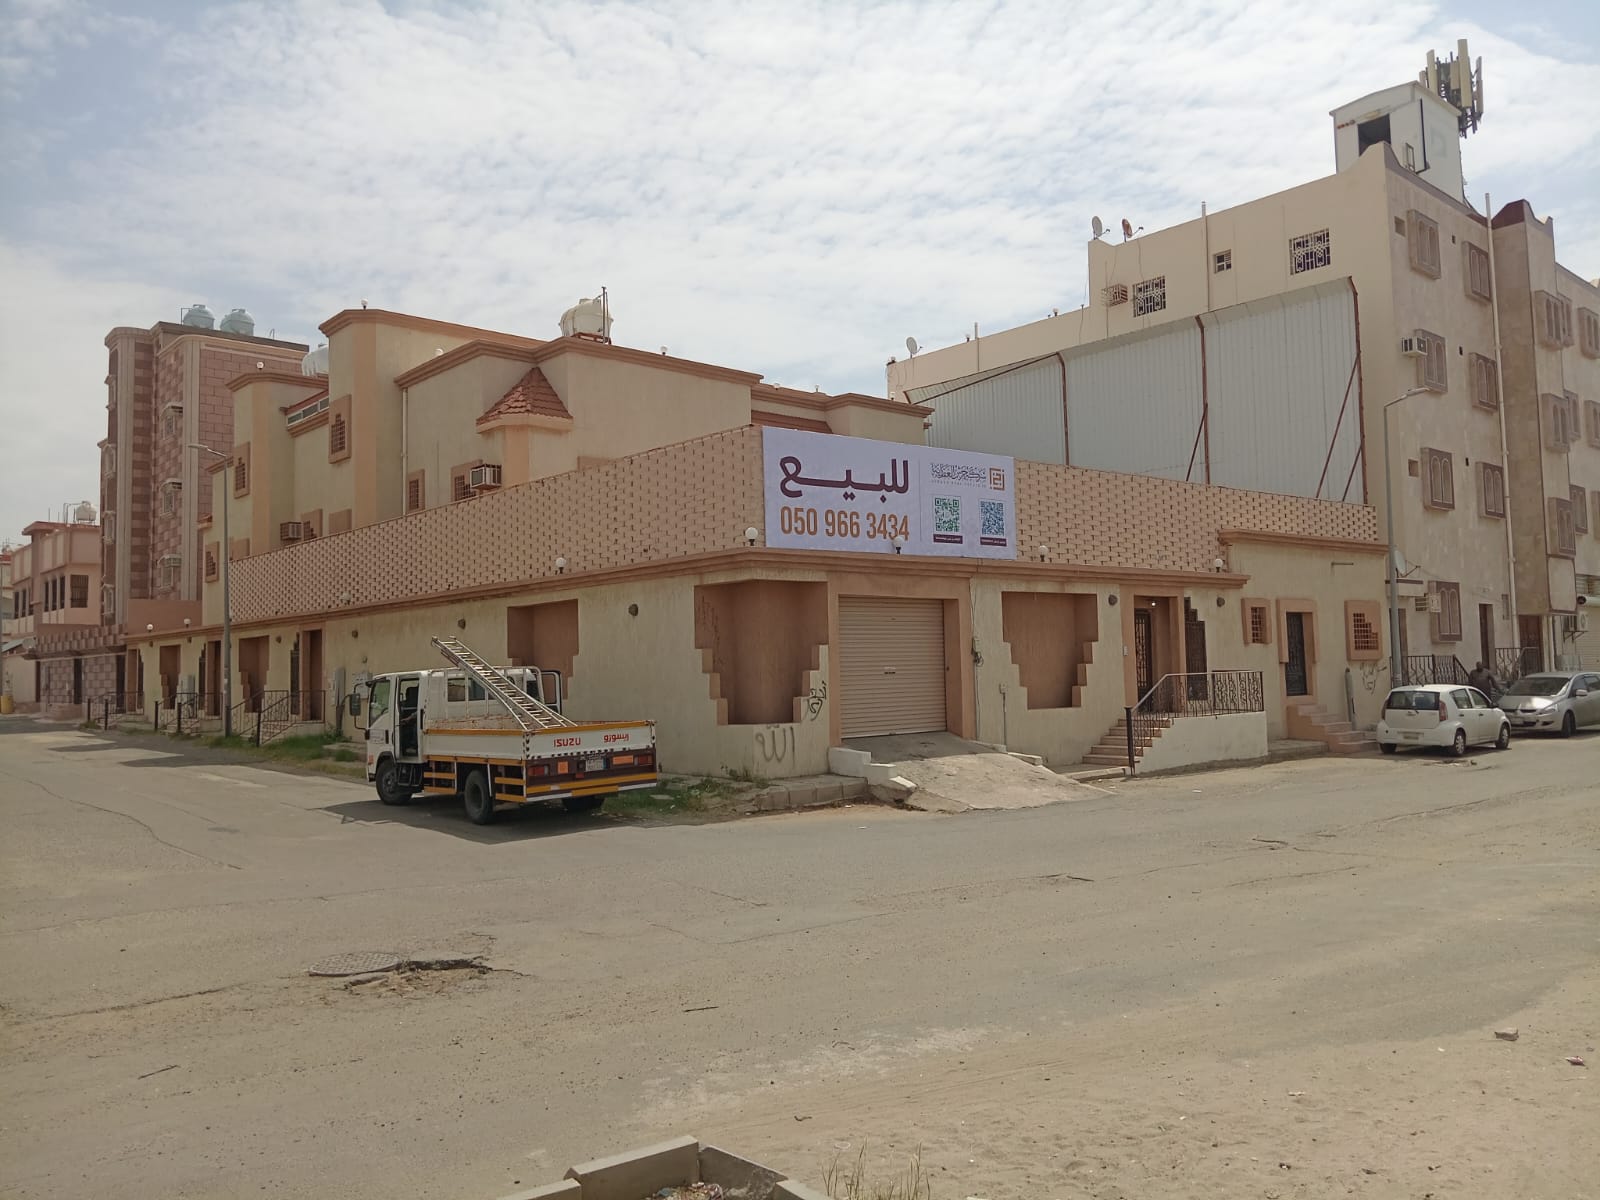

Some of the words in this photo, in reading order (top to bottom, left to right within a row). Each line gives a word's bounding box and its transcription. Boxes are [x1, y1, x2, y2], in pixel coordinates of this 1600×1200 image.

[780, 456, 909, 503] للبيع
[780, 506, 818, 536] 050
[824, 509, 860, 538] 966
[866, 512, 910, 541] 3434
[553, 738, 581, 748] ISUZU
